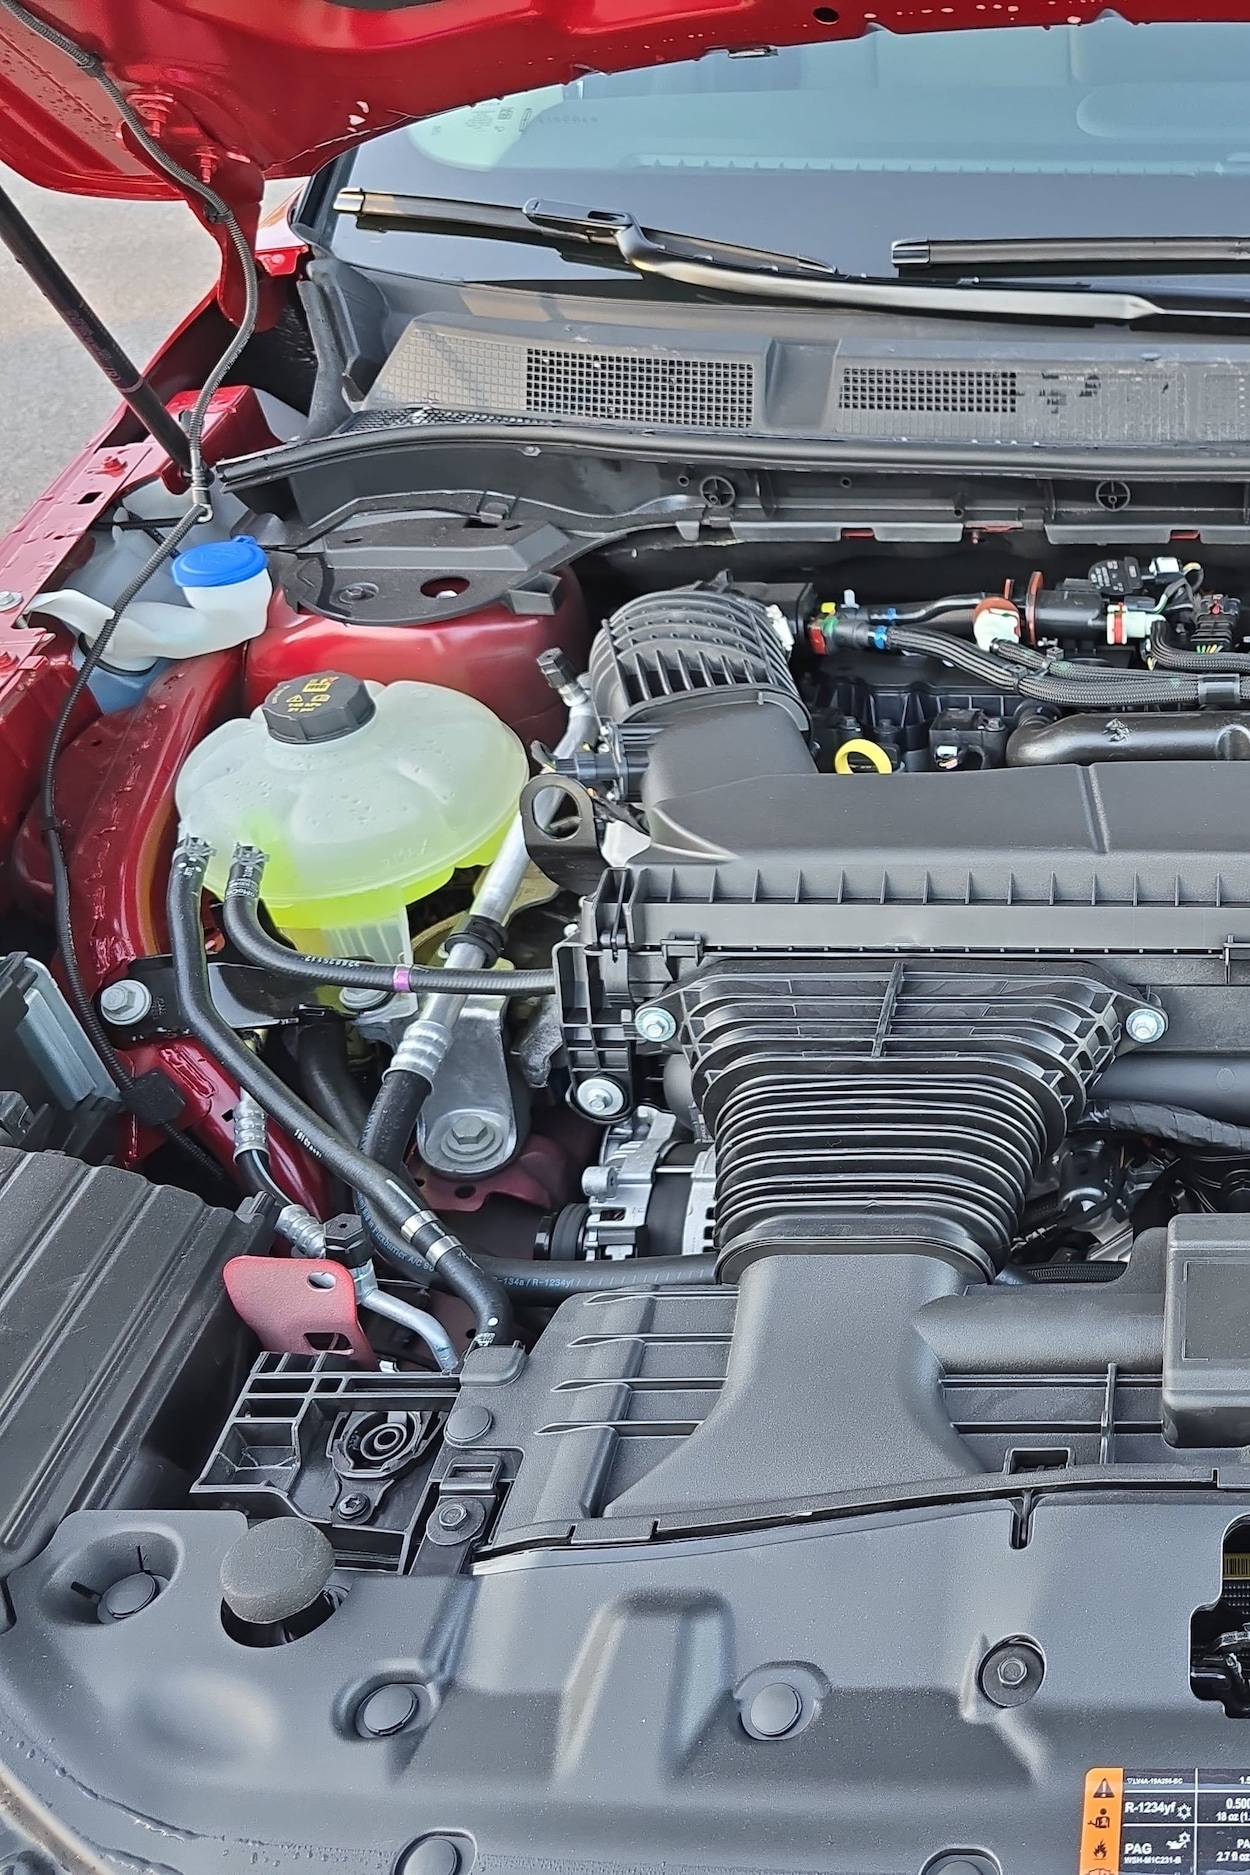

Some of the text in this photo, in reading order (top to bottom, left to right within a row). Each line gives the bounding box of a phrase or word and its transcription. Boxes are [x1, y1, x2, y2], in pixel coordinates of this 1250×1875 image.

[1124, 1801, 1175, 1815] R-1234yf
[1216, 1812, 1227, 1821] 18
[1124, 1843, 1152, 1855] PAG
[1216, 1852, 1230, 1862] 2.7
[1239, 1854, 1250, 1862] oz
